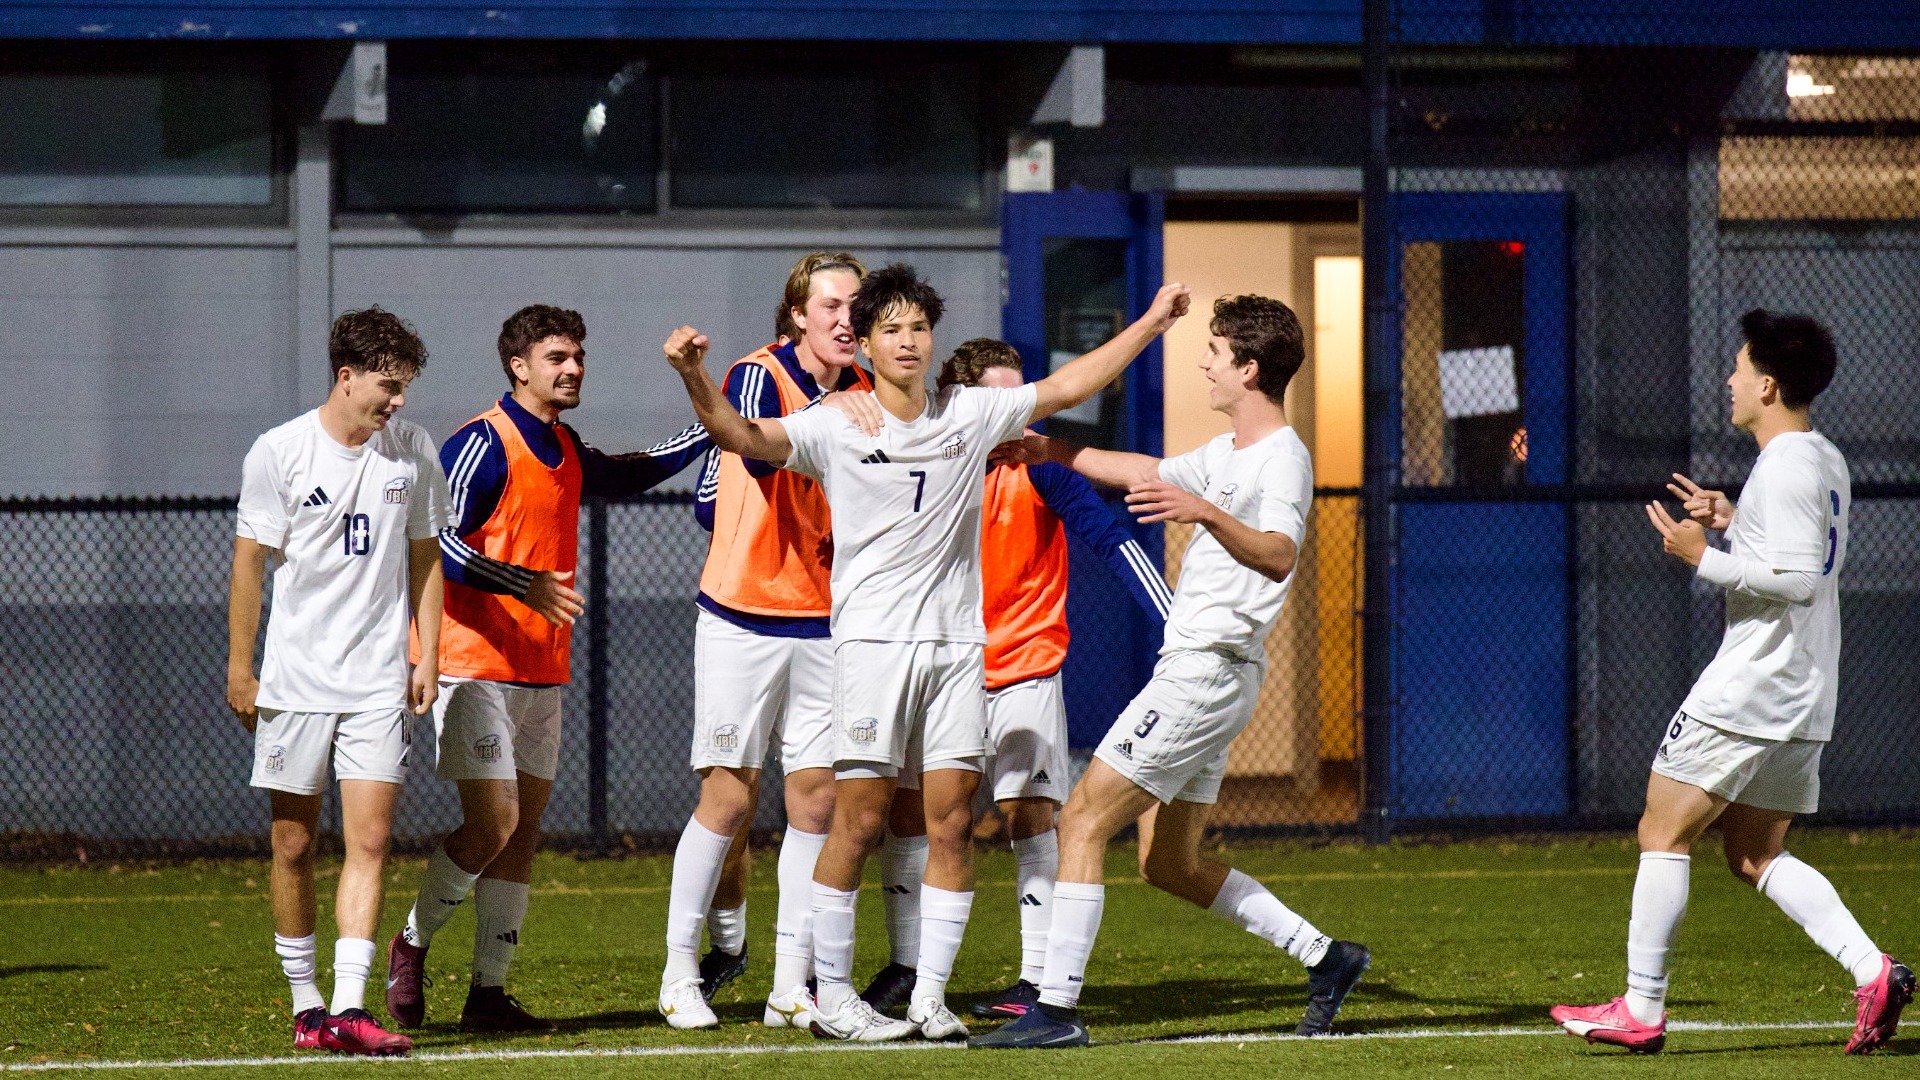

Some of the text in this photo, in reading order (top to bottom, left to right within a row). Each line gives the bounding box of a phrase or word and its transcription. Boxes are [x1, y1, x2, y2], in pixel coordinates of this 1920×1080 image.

[909, 470, 926, 513] 7
[342, 513, 370, 556] 10
[850, 728, 877, 742] UBC
[1134, 709, 1160, 739] 9
[1669, 710, 1687, 740] 6
[474, 745, 502, 759] UBC
[712, 734, 738, 748] UBC
